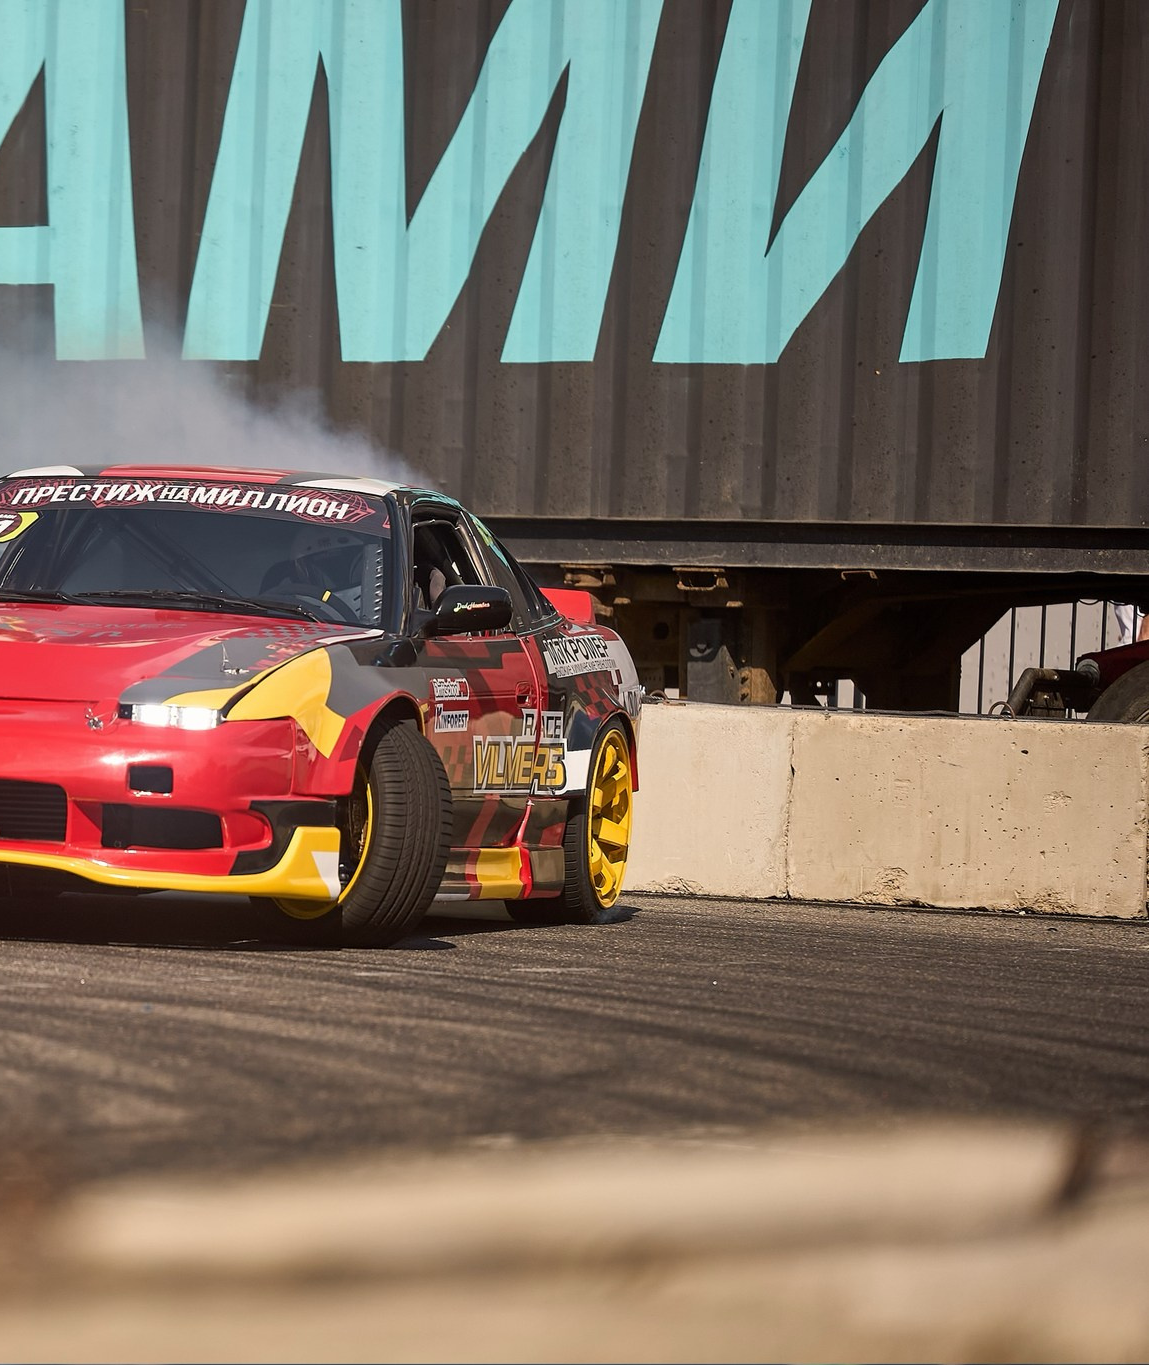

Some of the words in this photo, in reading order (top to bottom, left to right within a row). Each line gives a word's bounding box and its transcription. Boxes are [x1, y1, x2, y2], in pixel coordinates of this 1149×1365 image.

[11, 484, 164, 505] ПРЕСТИЖ
[160, 486, 190, 501] НА
[190, 486, 350, 519] МИЛЛИОН
[474, 741, 566, 789] VILMERS
